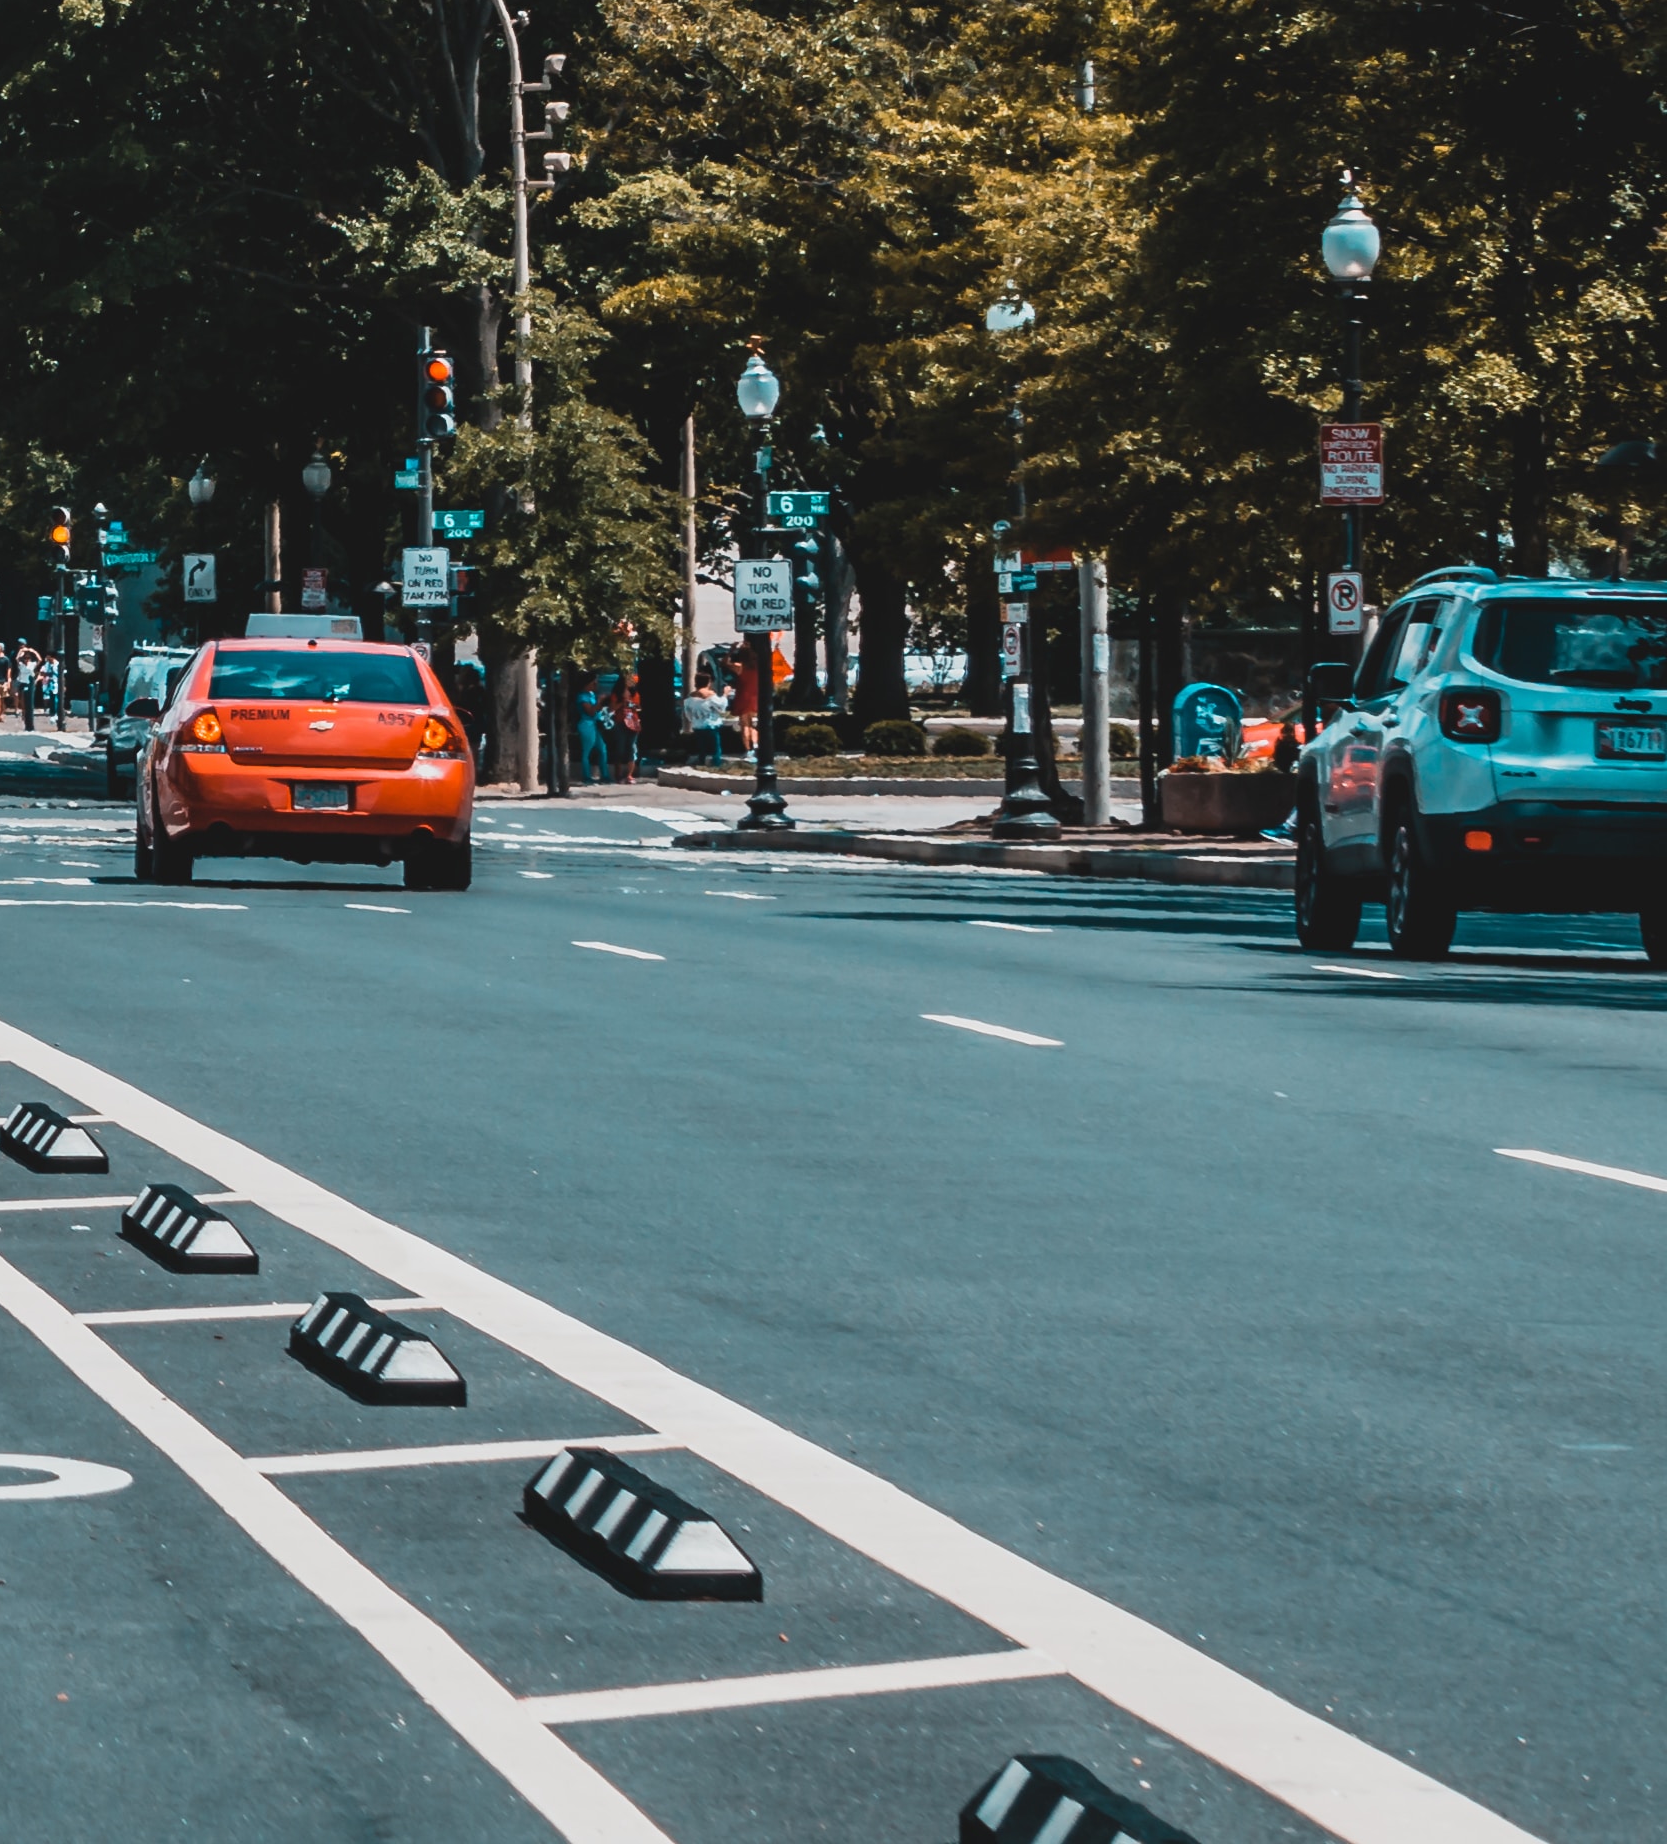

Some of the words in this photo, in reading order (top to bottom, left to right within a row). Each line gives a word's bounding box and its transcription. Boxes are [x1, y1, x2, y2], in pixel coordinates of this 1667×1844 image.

[1331, 428, 1370, 440] SNOW
[1328, 450, 1374, 462] ROUTE
[780, 495, 794, 513] 6
[810, 495, 823, 503] ST
[444, 513, 455, 528] 6
[786, 516, 814, 527] 200
[447, 528, 472, 538] 200
[418, 554, 433, 563] NO
[414, 566, 439, 575] TURN
[753, 567, 772, 578] NO
[408, 578, 421, 588] ON
[424, 578, 443, 588] RED
[747, 583, 779, 594] TURN
[188, 588, 212, 598] ONLY
[740, 598, 757, 610] ON
[762, 598, 787, 610] RED
[737, 614, 791, 626] 7AM-7PM
[230, 709, 290, 721] PREMIUM
[377, 712, 415, 726] A957
